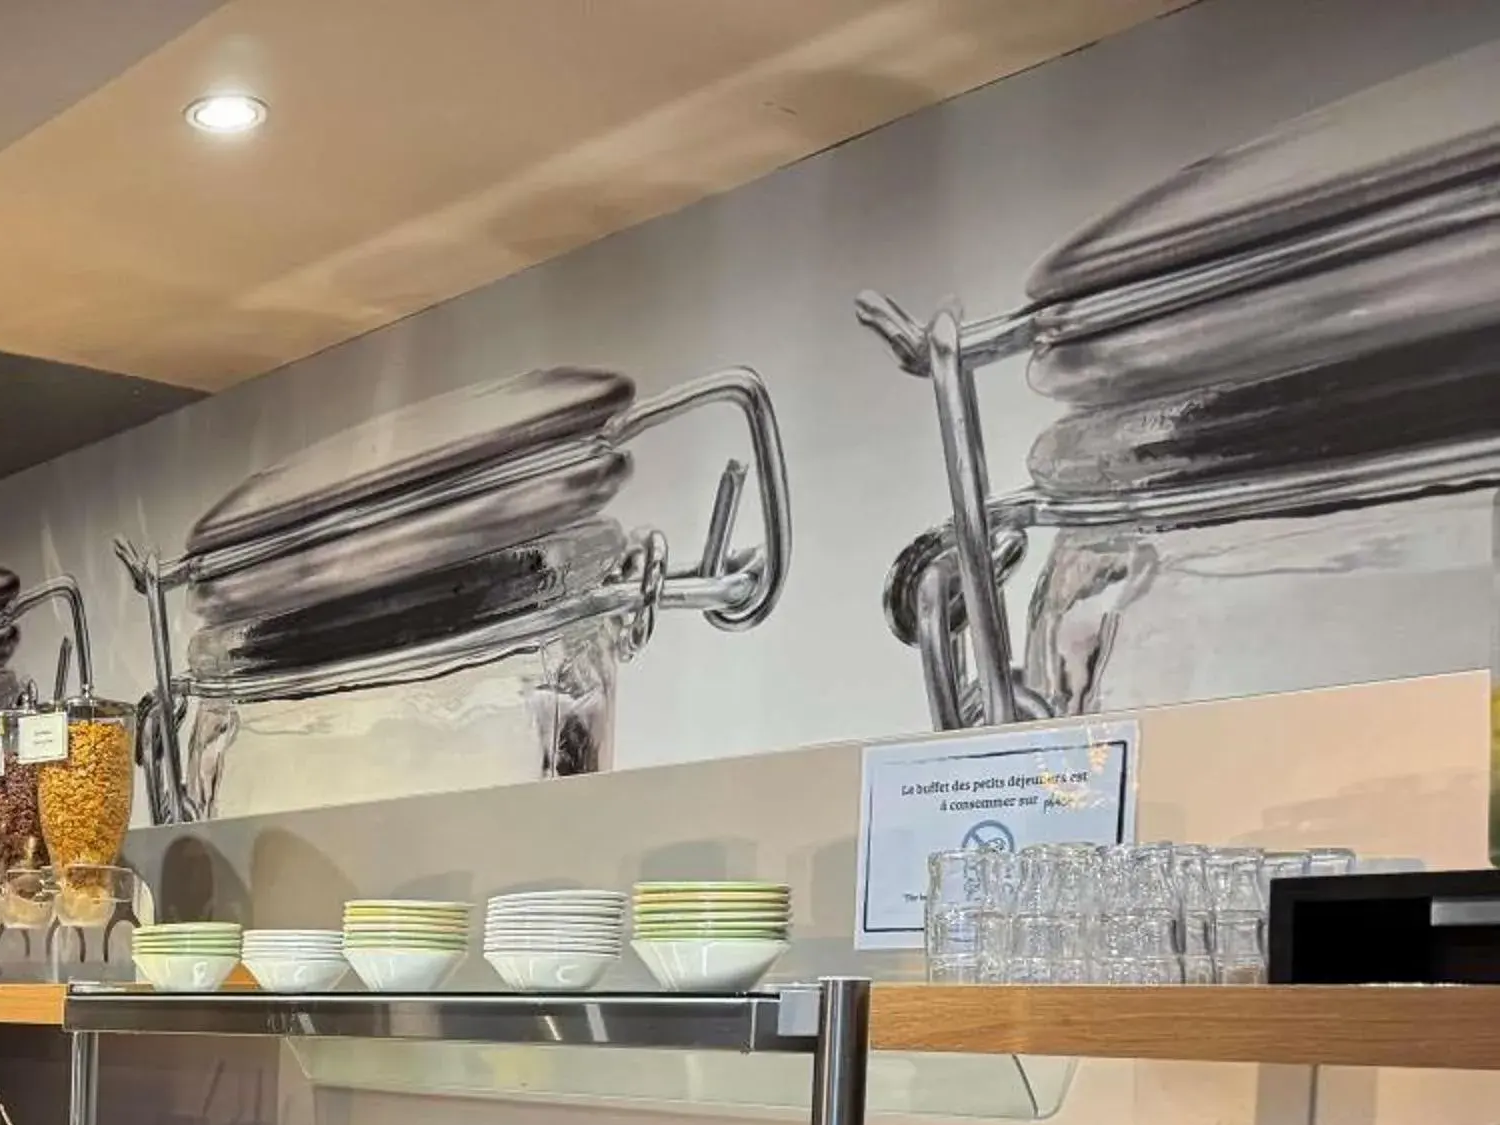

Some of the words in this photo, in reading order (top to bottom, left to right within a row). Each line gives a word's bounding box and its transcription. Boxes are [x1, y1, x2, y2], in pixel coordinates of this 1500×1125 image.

[916, 780, 950, 796] buffet
[951, 779, 971, 793] des
[972, 776, 1006, 793] petits
[1069, 770, 1088, 784] est
[949, 797, 1015, 812] consommer
[1018, 795, 1039, 807] sur
